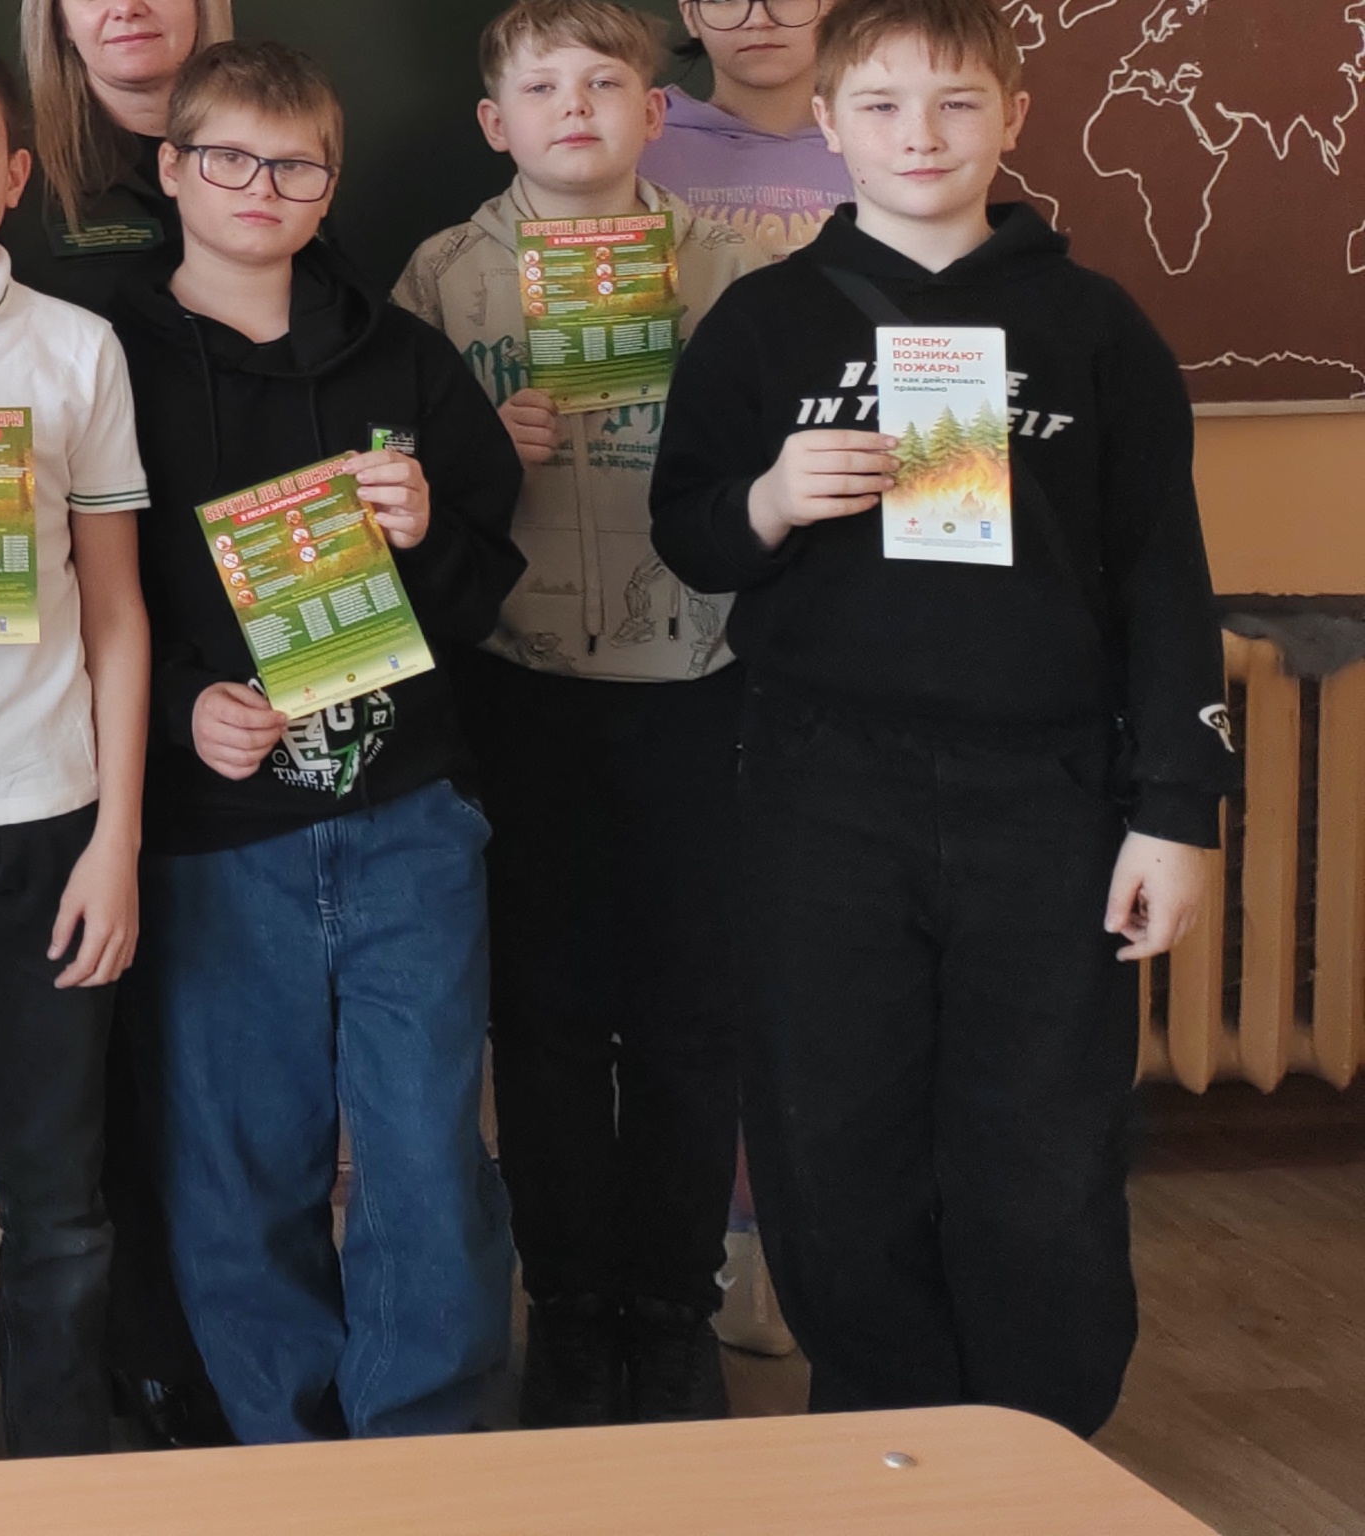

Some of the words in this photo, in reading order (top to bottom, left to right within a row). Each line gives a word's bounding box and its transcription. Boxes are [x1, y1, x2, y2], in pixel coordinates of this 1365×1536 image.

[892, 338, 951, 347] ПОЧЕМУ
[893, 350, 984, 361] ВОЗНИКАЮТ
[893, 363, 960, 372] ПОЖАРЫ
[796, 397, 844, 424] IN
[372, 710, 388, 725] 87
[273, 767, 318, 785] TIME
